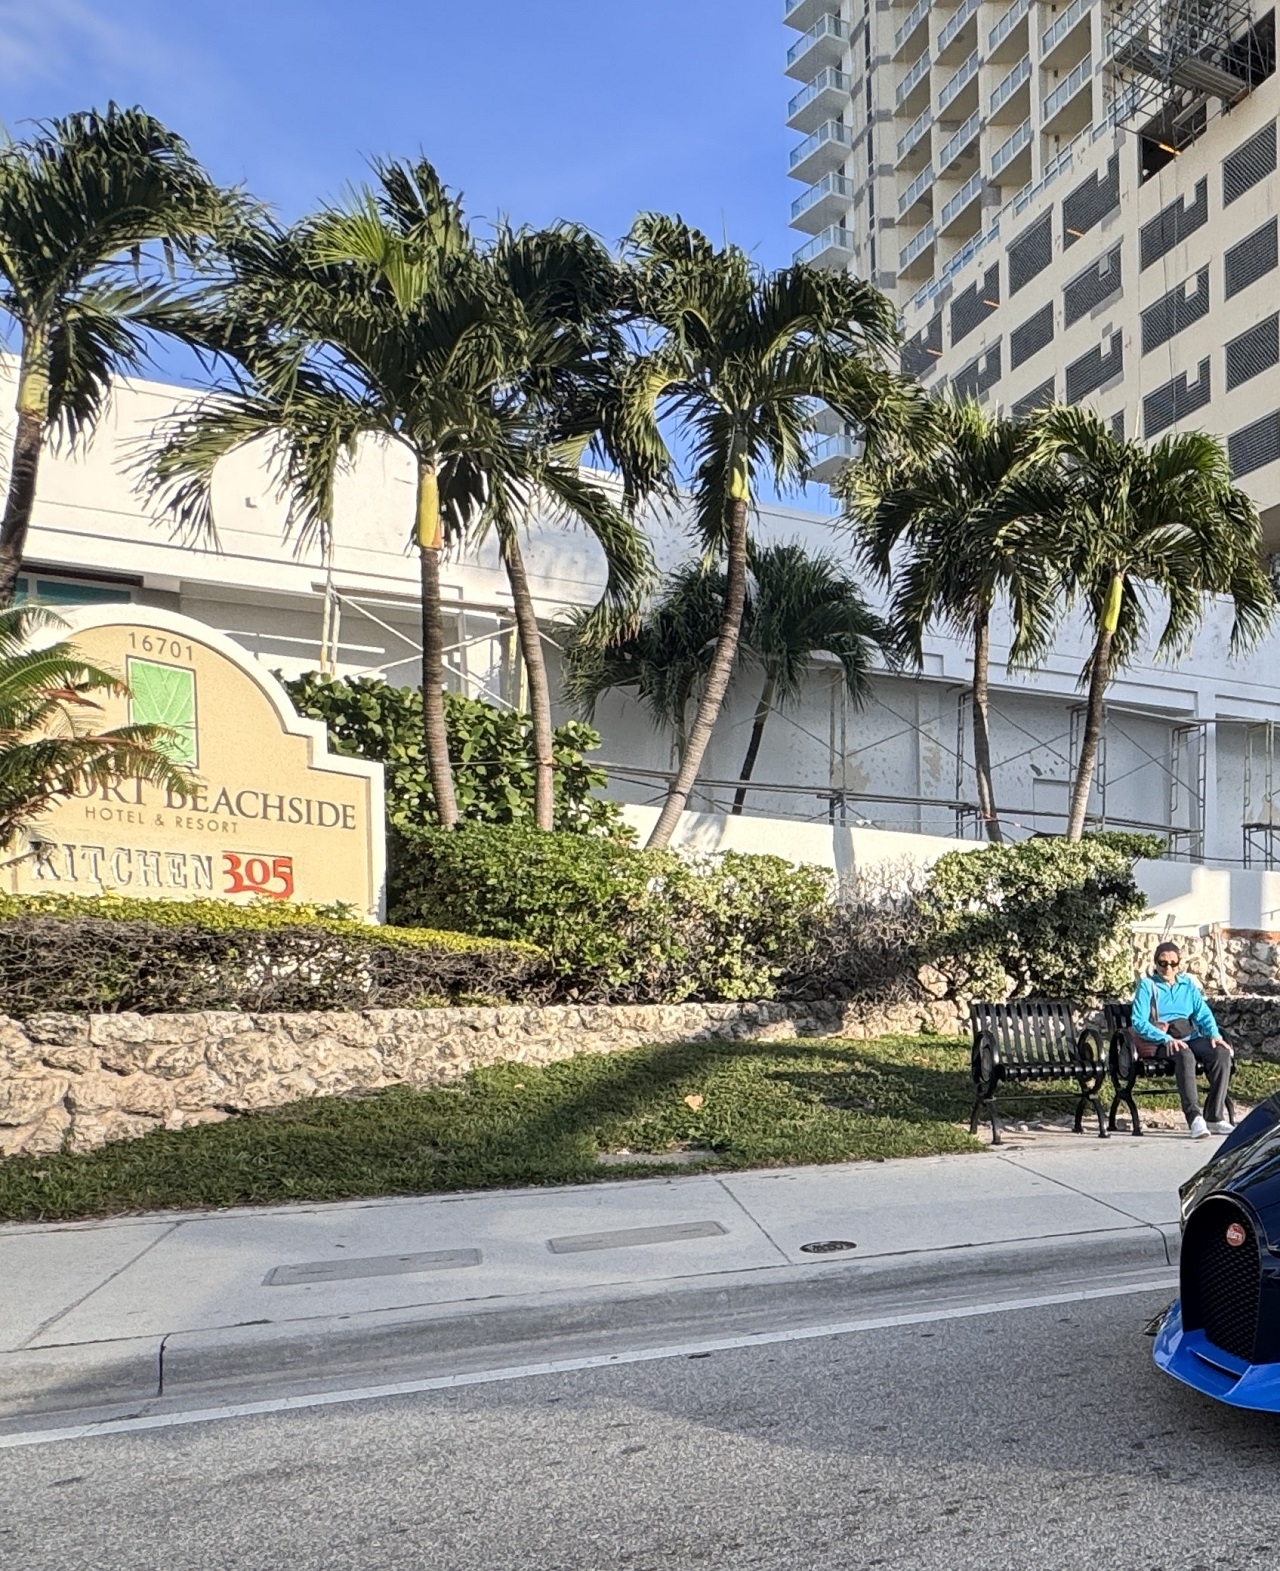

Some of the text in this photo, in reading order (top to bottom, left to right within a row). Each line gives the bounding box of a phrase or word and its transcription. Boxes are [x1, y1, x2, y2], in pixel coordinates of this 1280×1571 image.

[128, 631, 193, 662] 16701
[84, 806, 238, 834] HOTEL & RESORT
[163, 779, 357, 831] BEACHSIDE
[28, 841, 294, 899] KITCHEN 305
